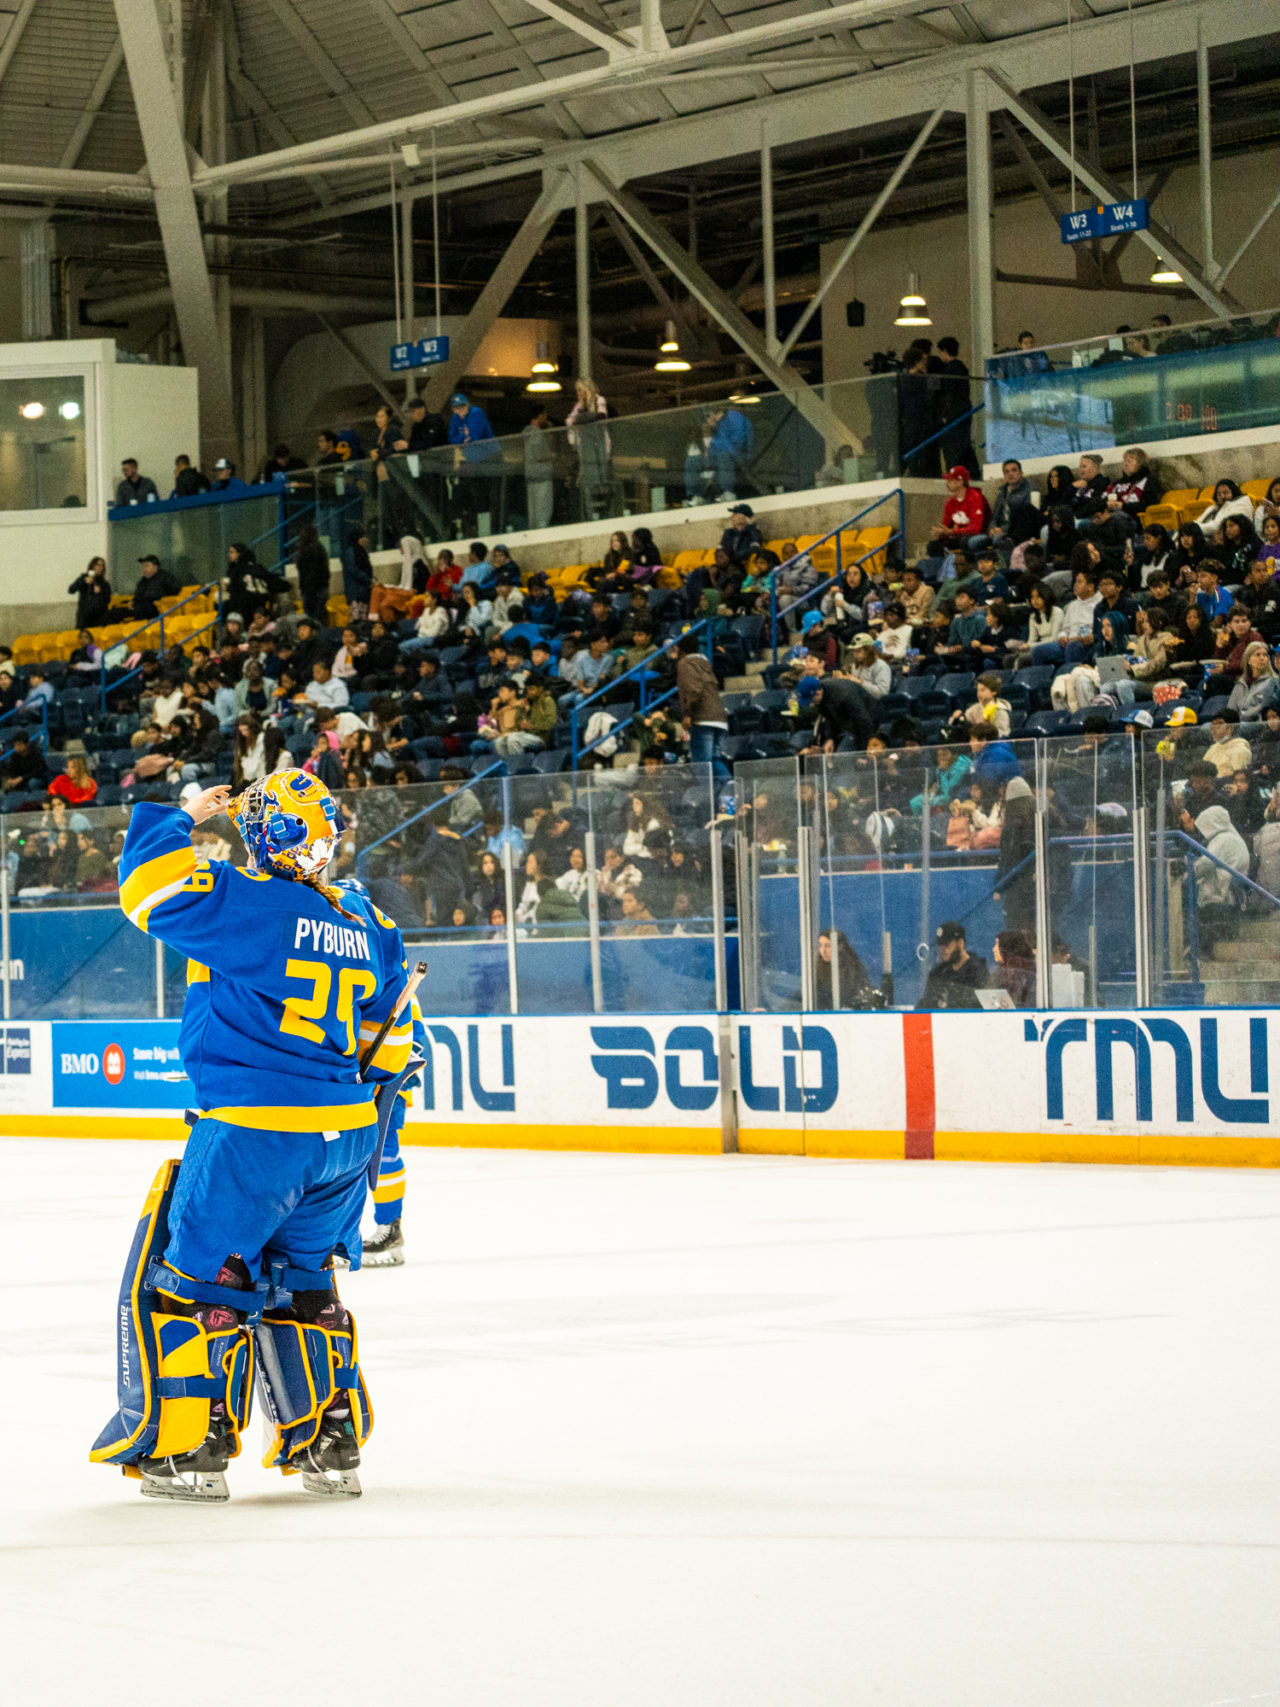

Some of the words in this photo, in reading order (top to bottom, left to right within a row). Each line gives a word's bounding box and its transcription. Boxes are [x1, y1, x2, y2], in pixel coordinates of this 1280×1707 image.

[1070, 214, 1087, 230] W3
[1113, 205, 1134, 221] W4
[294, 917, 371, 961] PYBURN
[61, 1053, 99, 1074] BMO
[423, 1024, 516, 1112] MU
[590, 1025, 840, 1113] BOLD
[1024, 1017, 1269, 1123] TMU
[121, 1304, 131, 1389] SUPREME
